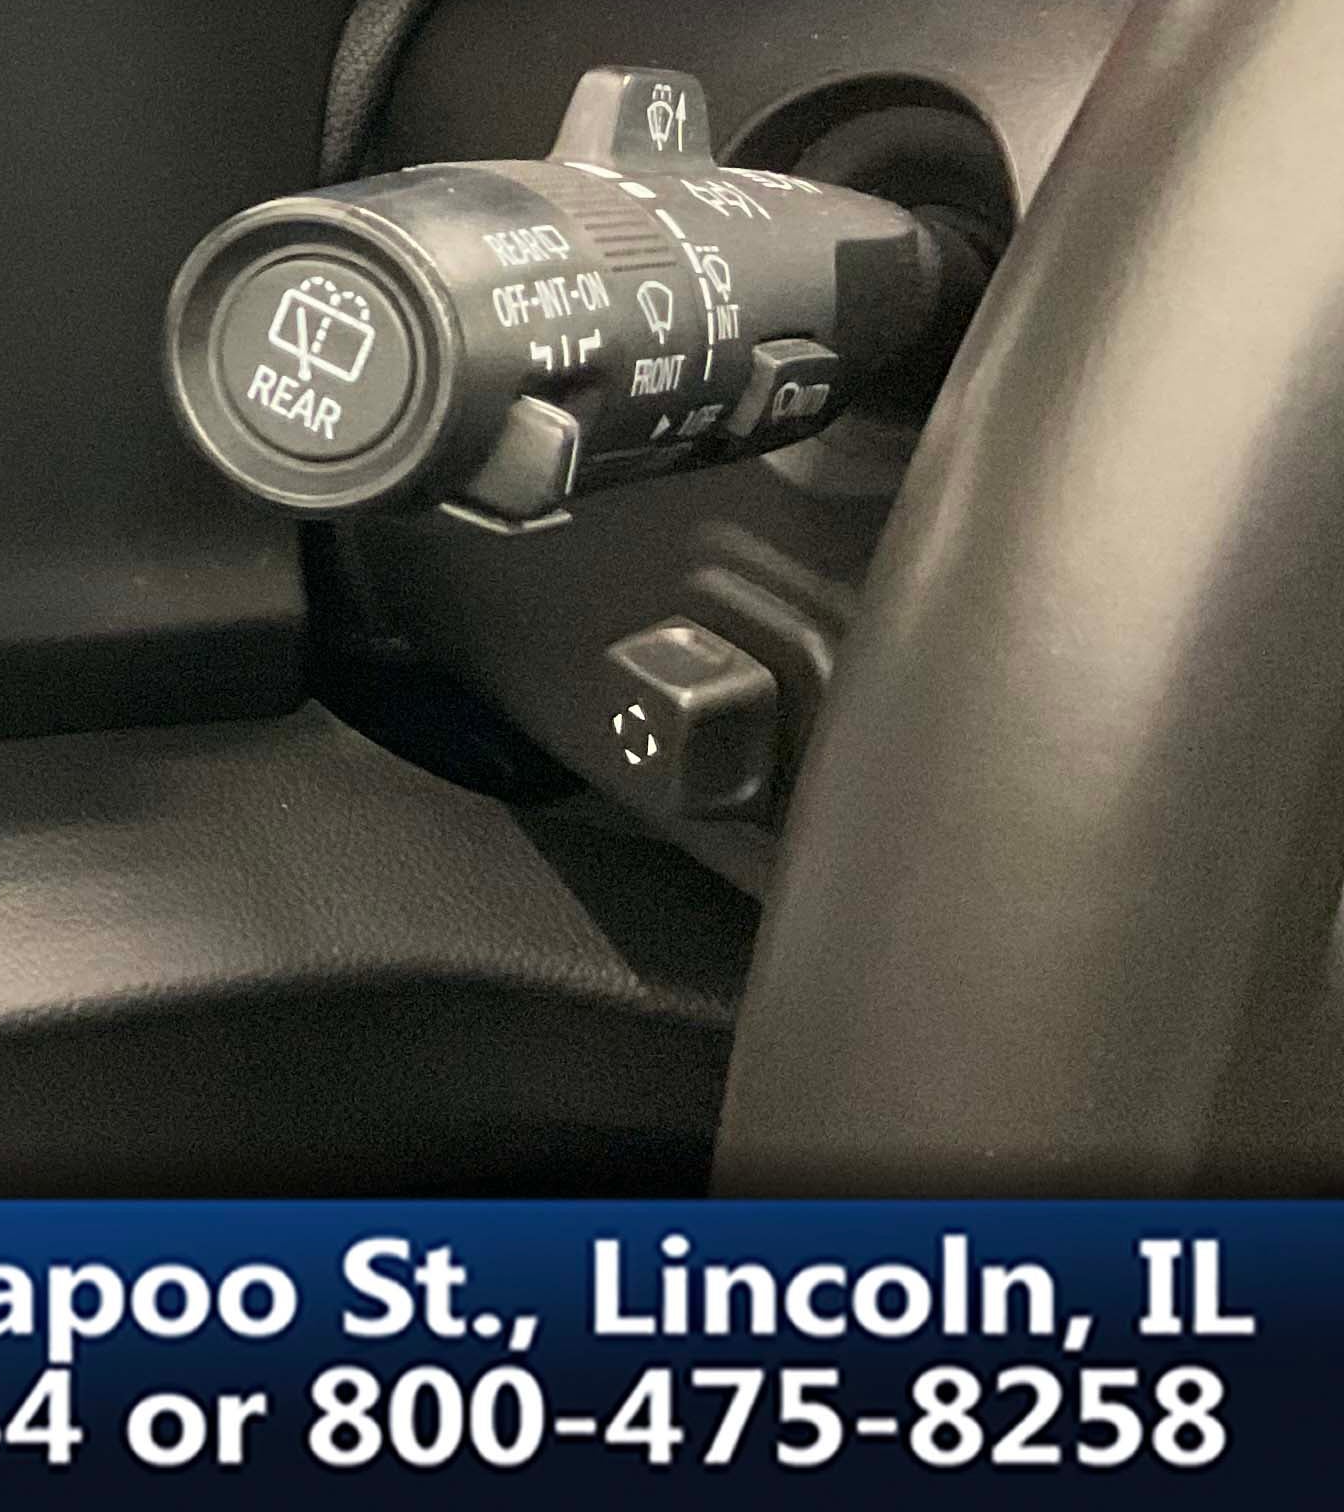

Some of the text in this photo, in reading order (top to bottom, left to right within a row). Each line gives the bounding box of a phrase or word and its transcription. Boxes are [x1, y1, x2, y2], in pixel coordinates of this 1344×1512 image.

[483, 228, 551, 266] REAR
[630, 354, 686, 397] FRONT
[247, 364, 342, 440] REAR
